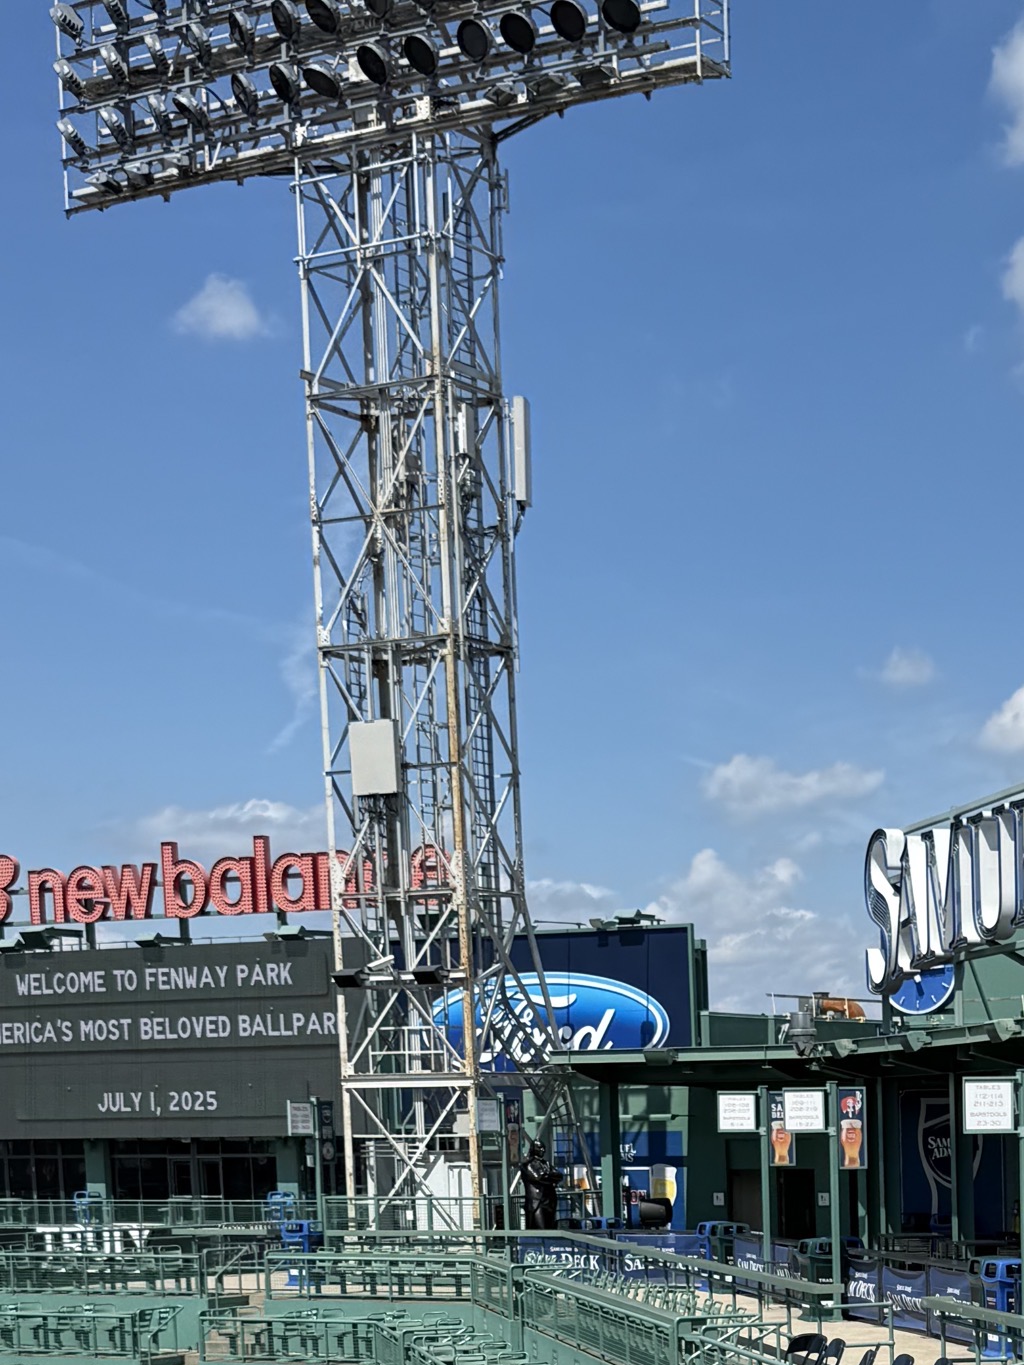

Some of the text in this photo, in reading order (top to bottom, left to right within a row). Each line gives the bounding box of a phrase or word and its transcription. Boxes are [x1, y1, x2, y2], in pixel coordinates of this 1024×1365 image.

[16, 962, 293, 996] WELCOME TO FENWAY PARK
[0, 1019, 73, 1044] ERICA'S
[80, 1018, 132, 1042] MOST
[140, 1015, 231, 1041] BELOVED
[98, 1090, 218, 1116] JULY 1, 2025
[771, 1103, 783, 1112] SA
